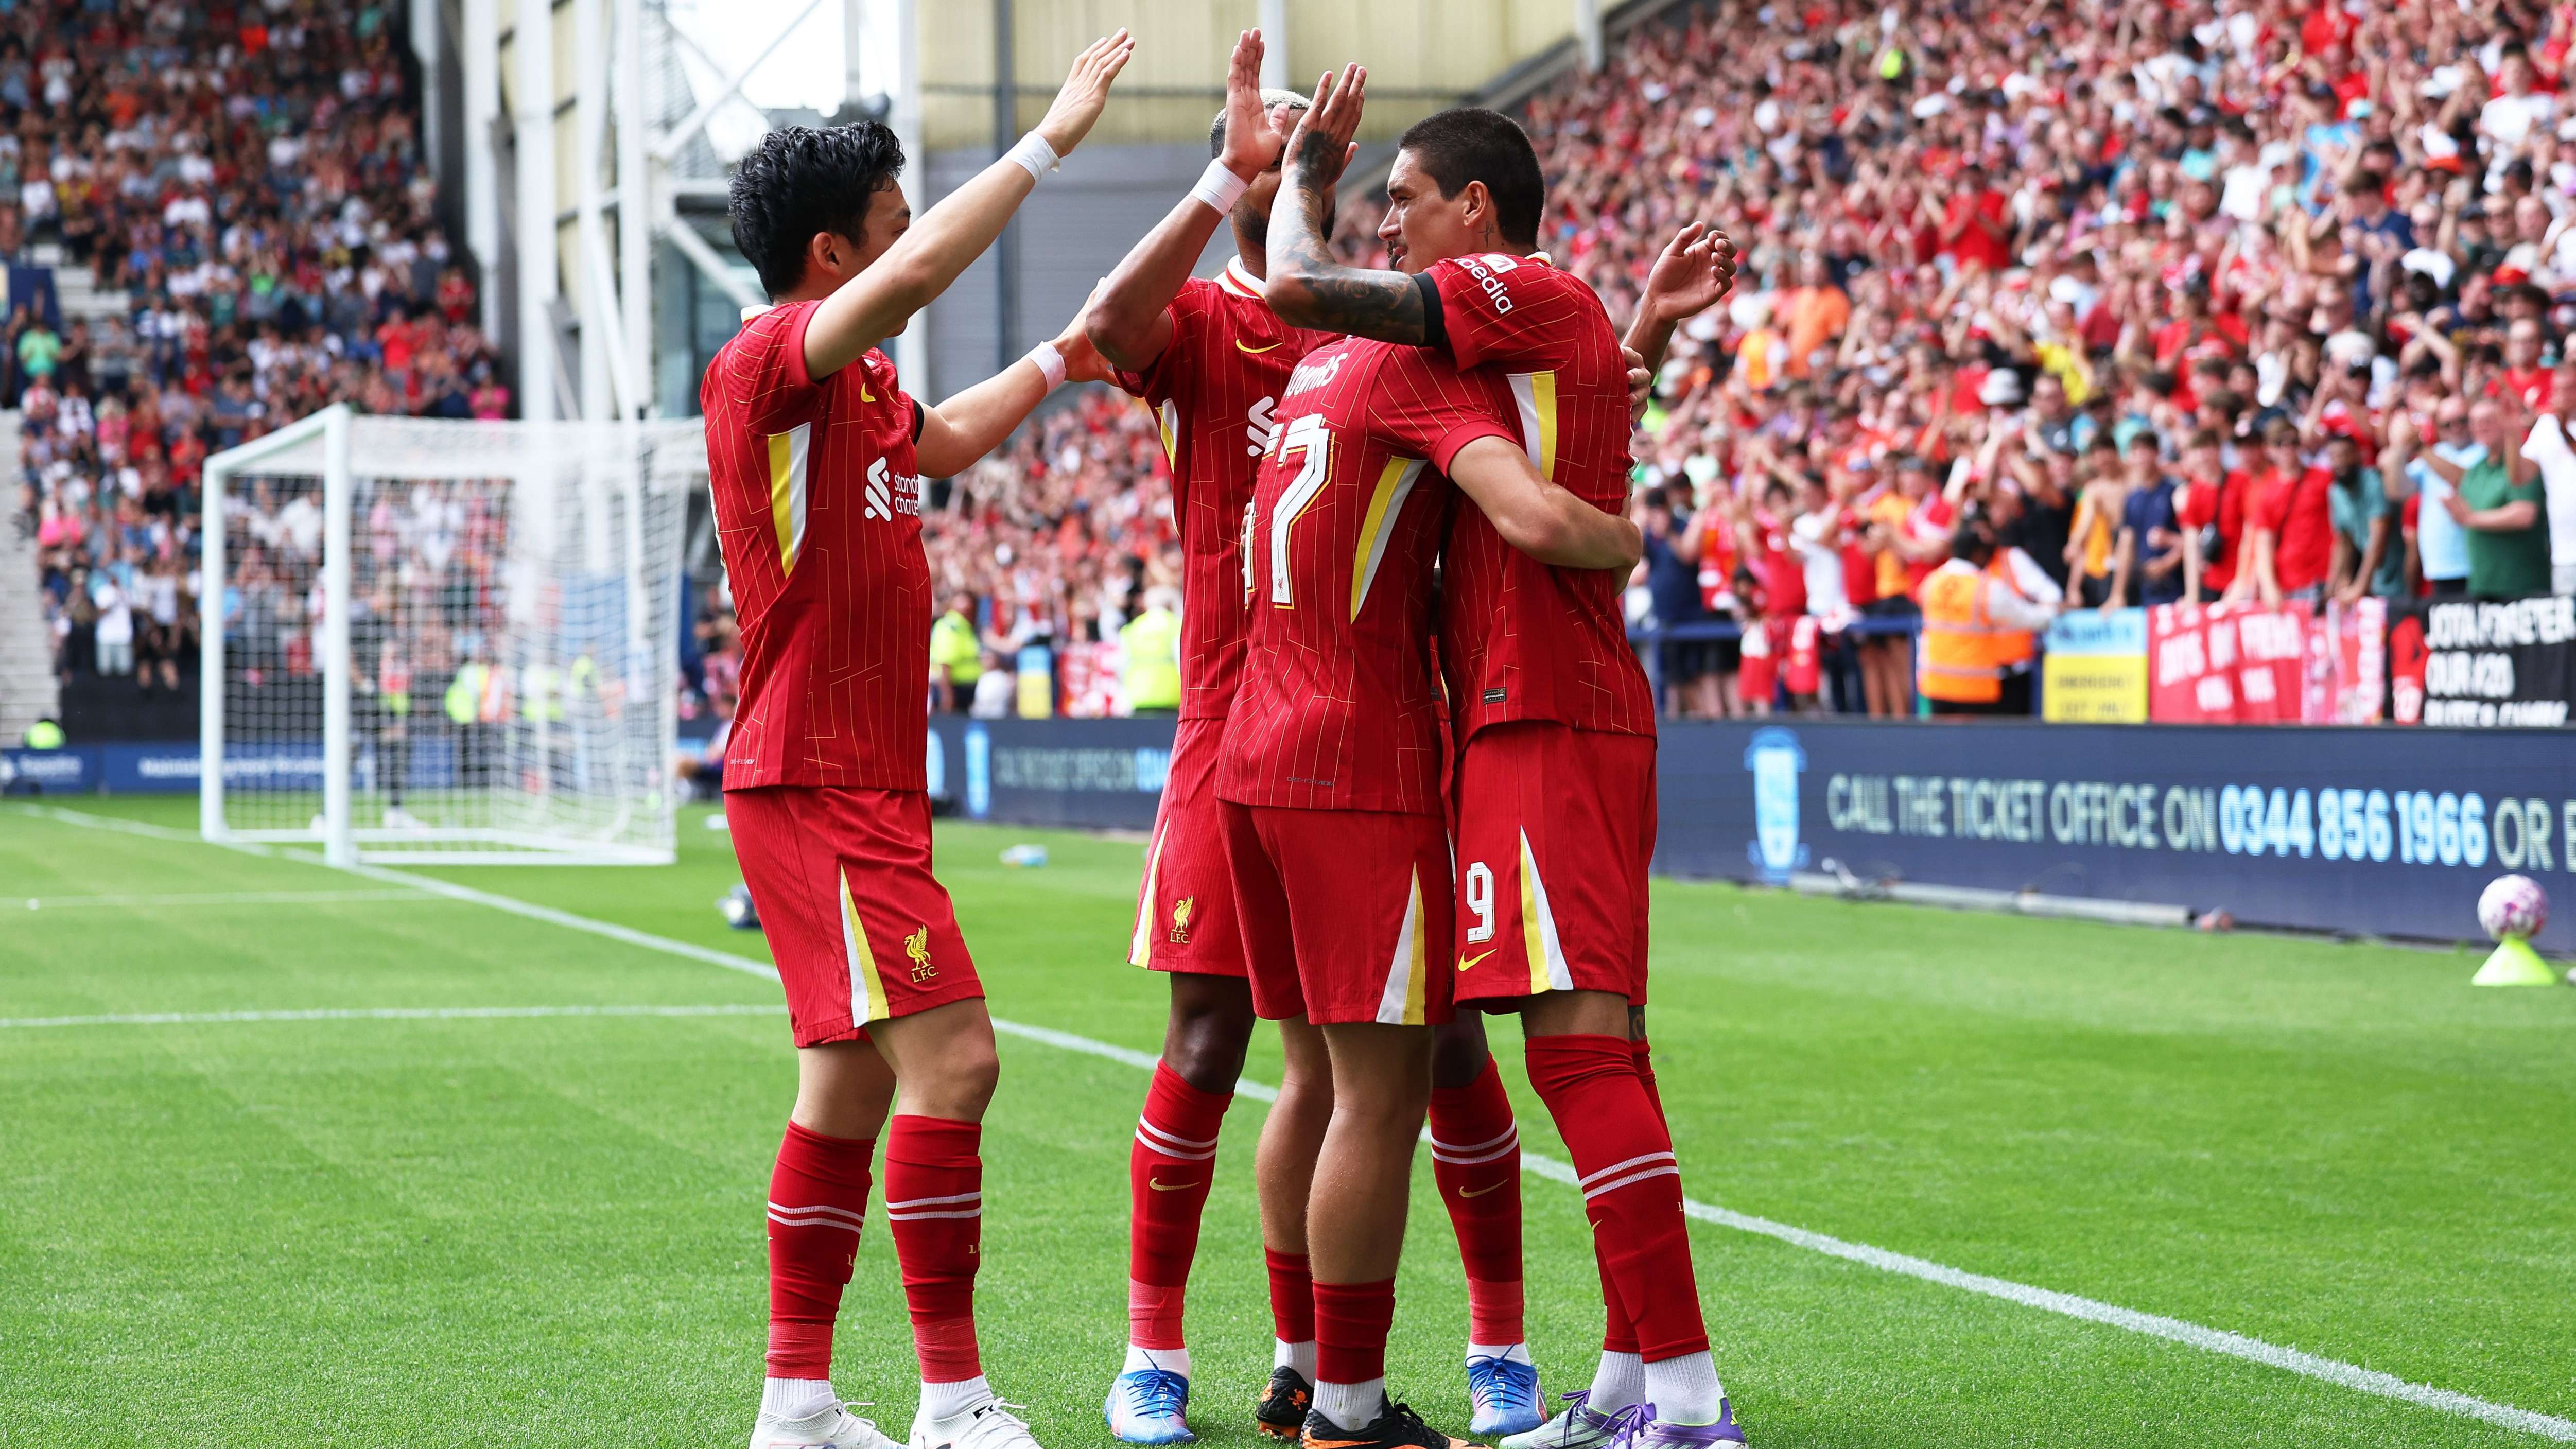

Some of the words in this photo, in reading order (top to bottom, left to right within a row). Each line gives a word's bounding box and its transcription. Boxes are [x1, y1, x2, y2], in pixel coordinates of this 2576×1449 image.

[2425, 651, 2471, 697] OUR
[1826, 773, 1894, 834] CALL
[1892, 776, 1948, 837] THE
[1948, 776, 2048, 844] TICKET
[2049, 780, 2161, 849] OFFICE
[2163, 785, 2218, 853] ON
[2219, 783, 2316, 859] 0344
[2318, 786, 2394, 862] 856
[2394, 789, 2490, 867] 1966
[2493, 797, 2555, 872] OR
[1466, 861, 1494, 944] 9
[911, 966, 939, 984] L.F.C.
